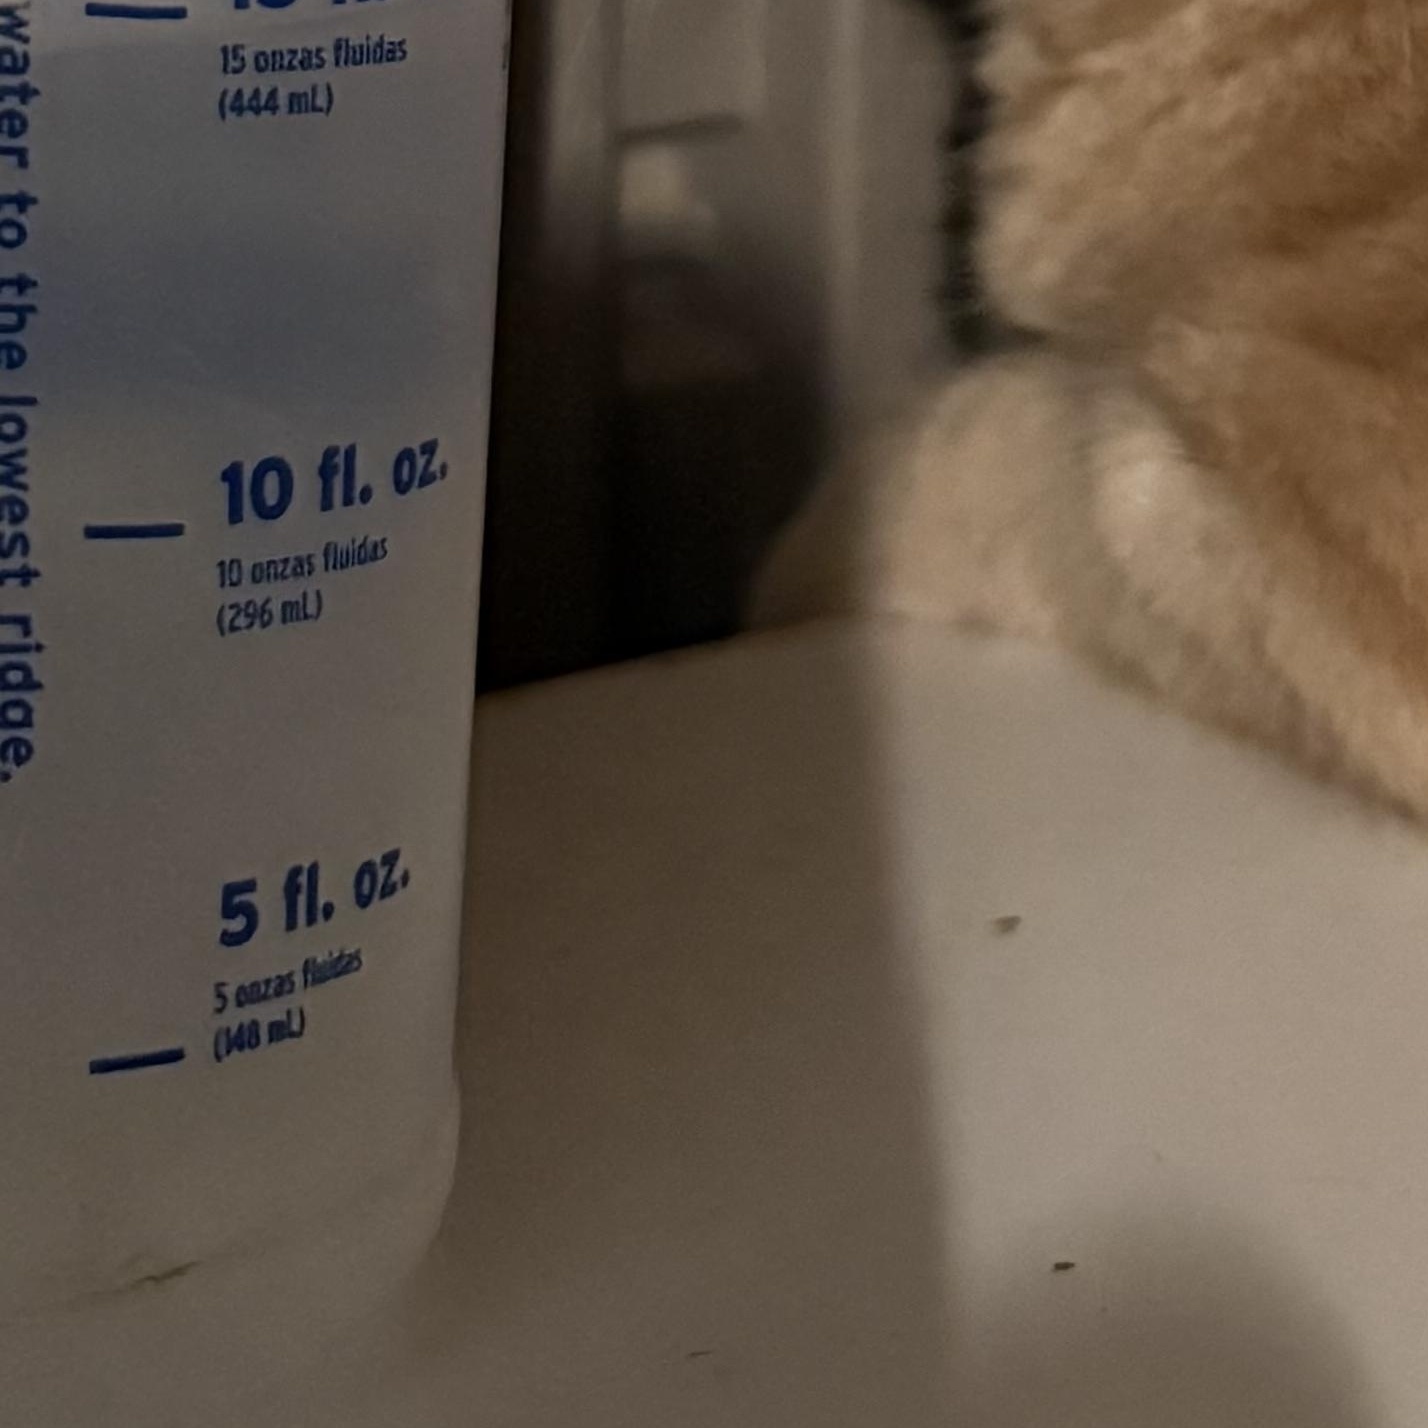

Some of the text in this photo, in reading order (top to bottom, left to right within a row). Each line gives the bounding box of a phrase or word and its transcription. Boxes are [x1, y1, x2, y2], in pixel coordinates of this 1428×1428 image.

[0, 0, 40, 169] water
[219, 36, 407, 75] 15 onzas fluidas
[218, 82, 334, 121] (444 mL)
[0, 189, 38, 250] to
[0, 274, 38, 371] the
[0, 394, 40, 590] lowest
[220, 438, 448, 525] 10 fl. oz.
[217, 535, 388, 589] 10 onzas fluidas
[216, 589, 324, 636] (296 mL)
[219, 848, 410, 947] 5 fl. oz.
